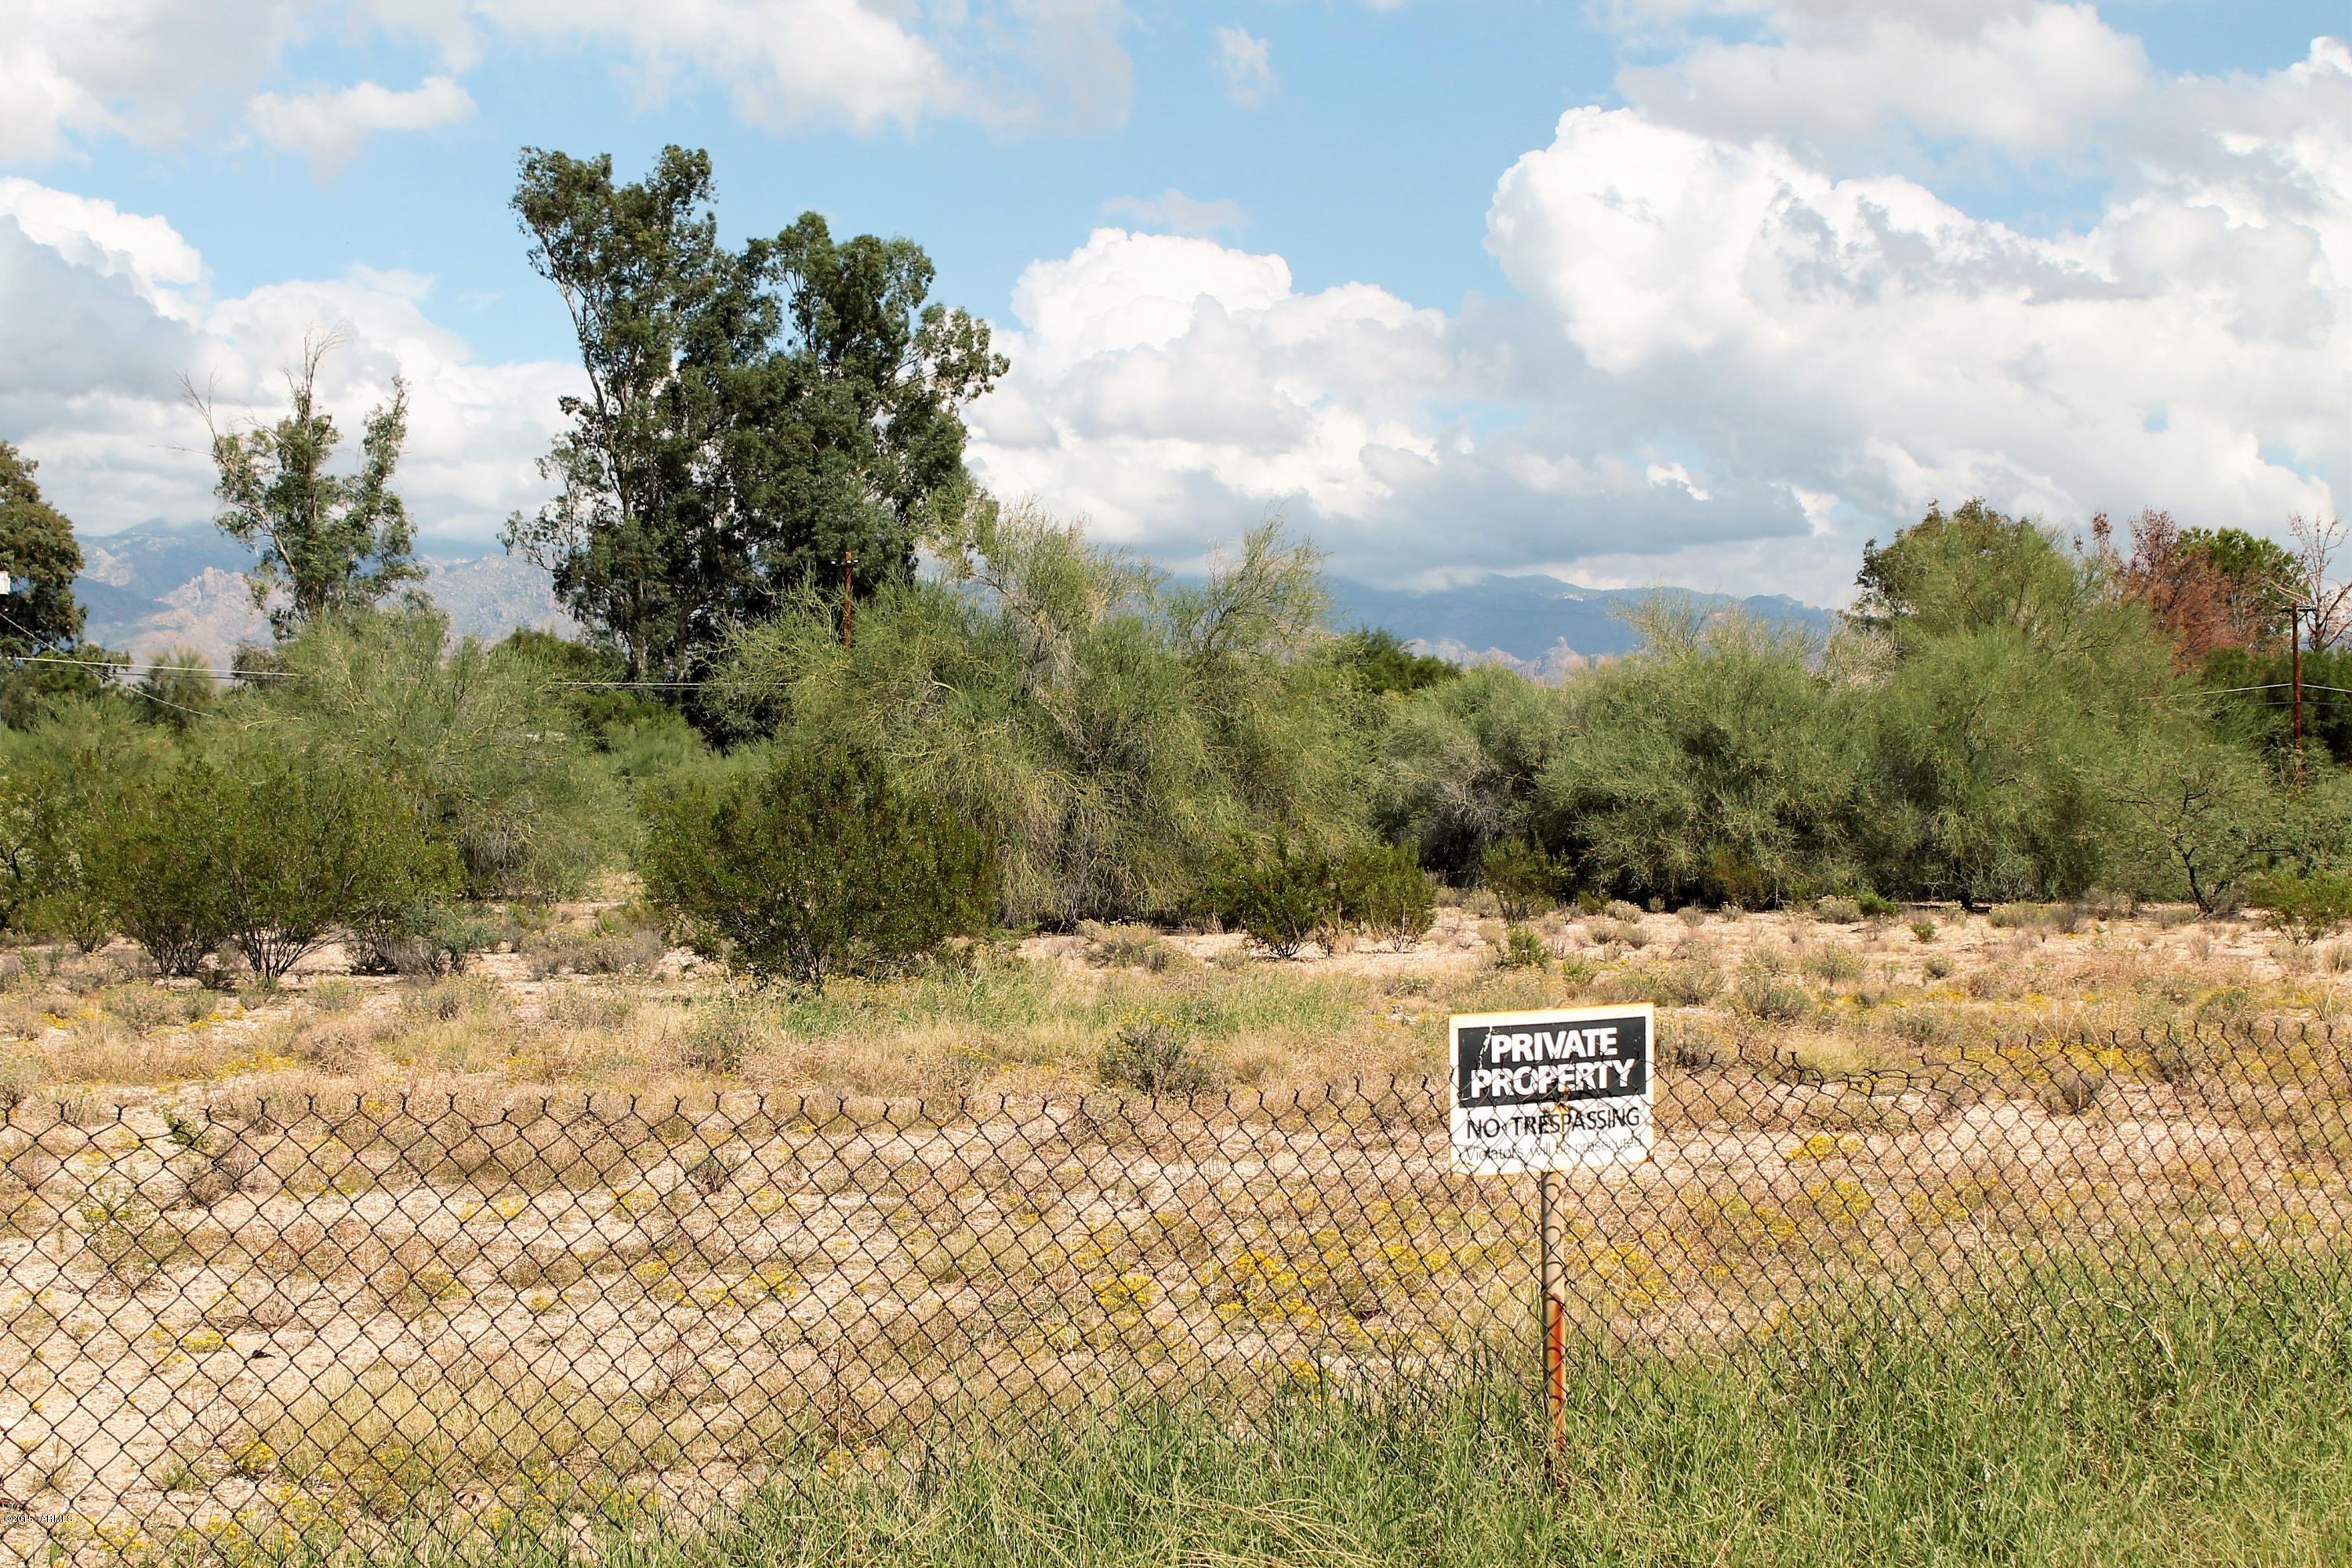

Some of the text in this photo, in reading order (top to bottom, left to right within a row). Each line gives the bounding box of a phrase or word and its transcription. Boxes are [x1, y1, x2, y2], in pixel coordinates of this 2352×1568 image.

[1491, 1027, 1617, 1063] PRIVATE
[1471, 1058, 1635, 1098] PROPERTY
[1467, 1106, 1639, 1138] NO TRESPASSING
[1465, 1144, 1524, 1161] Violators
[1529, 1142, 1552, 1158] will
[1574, 1134, 1642, 1156] prosecuted
